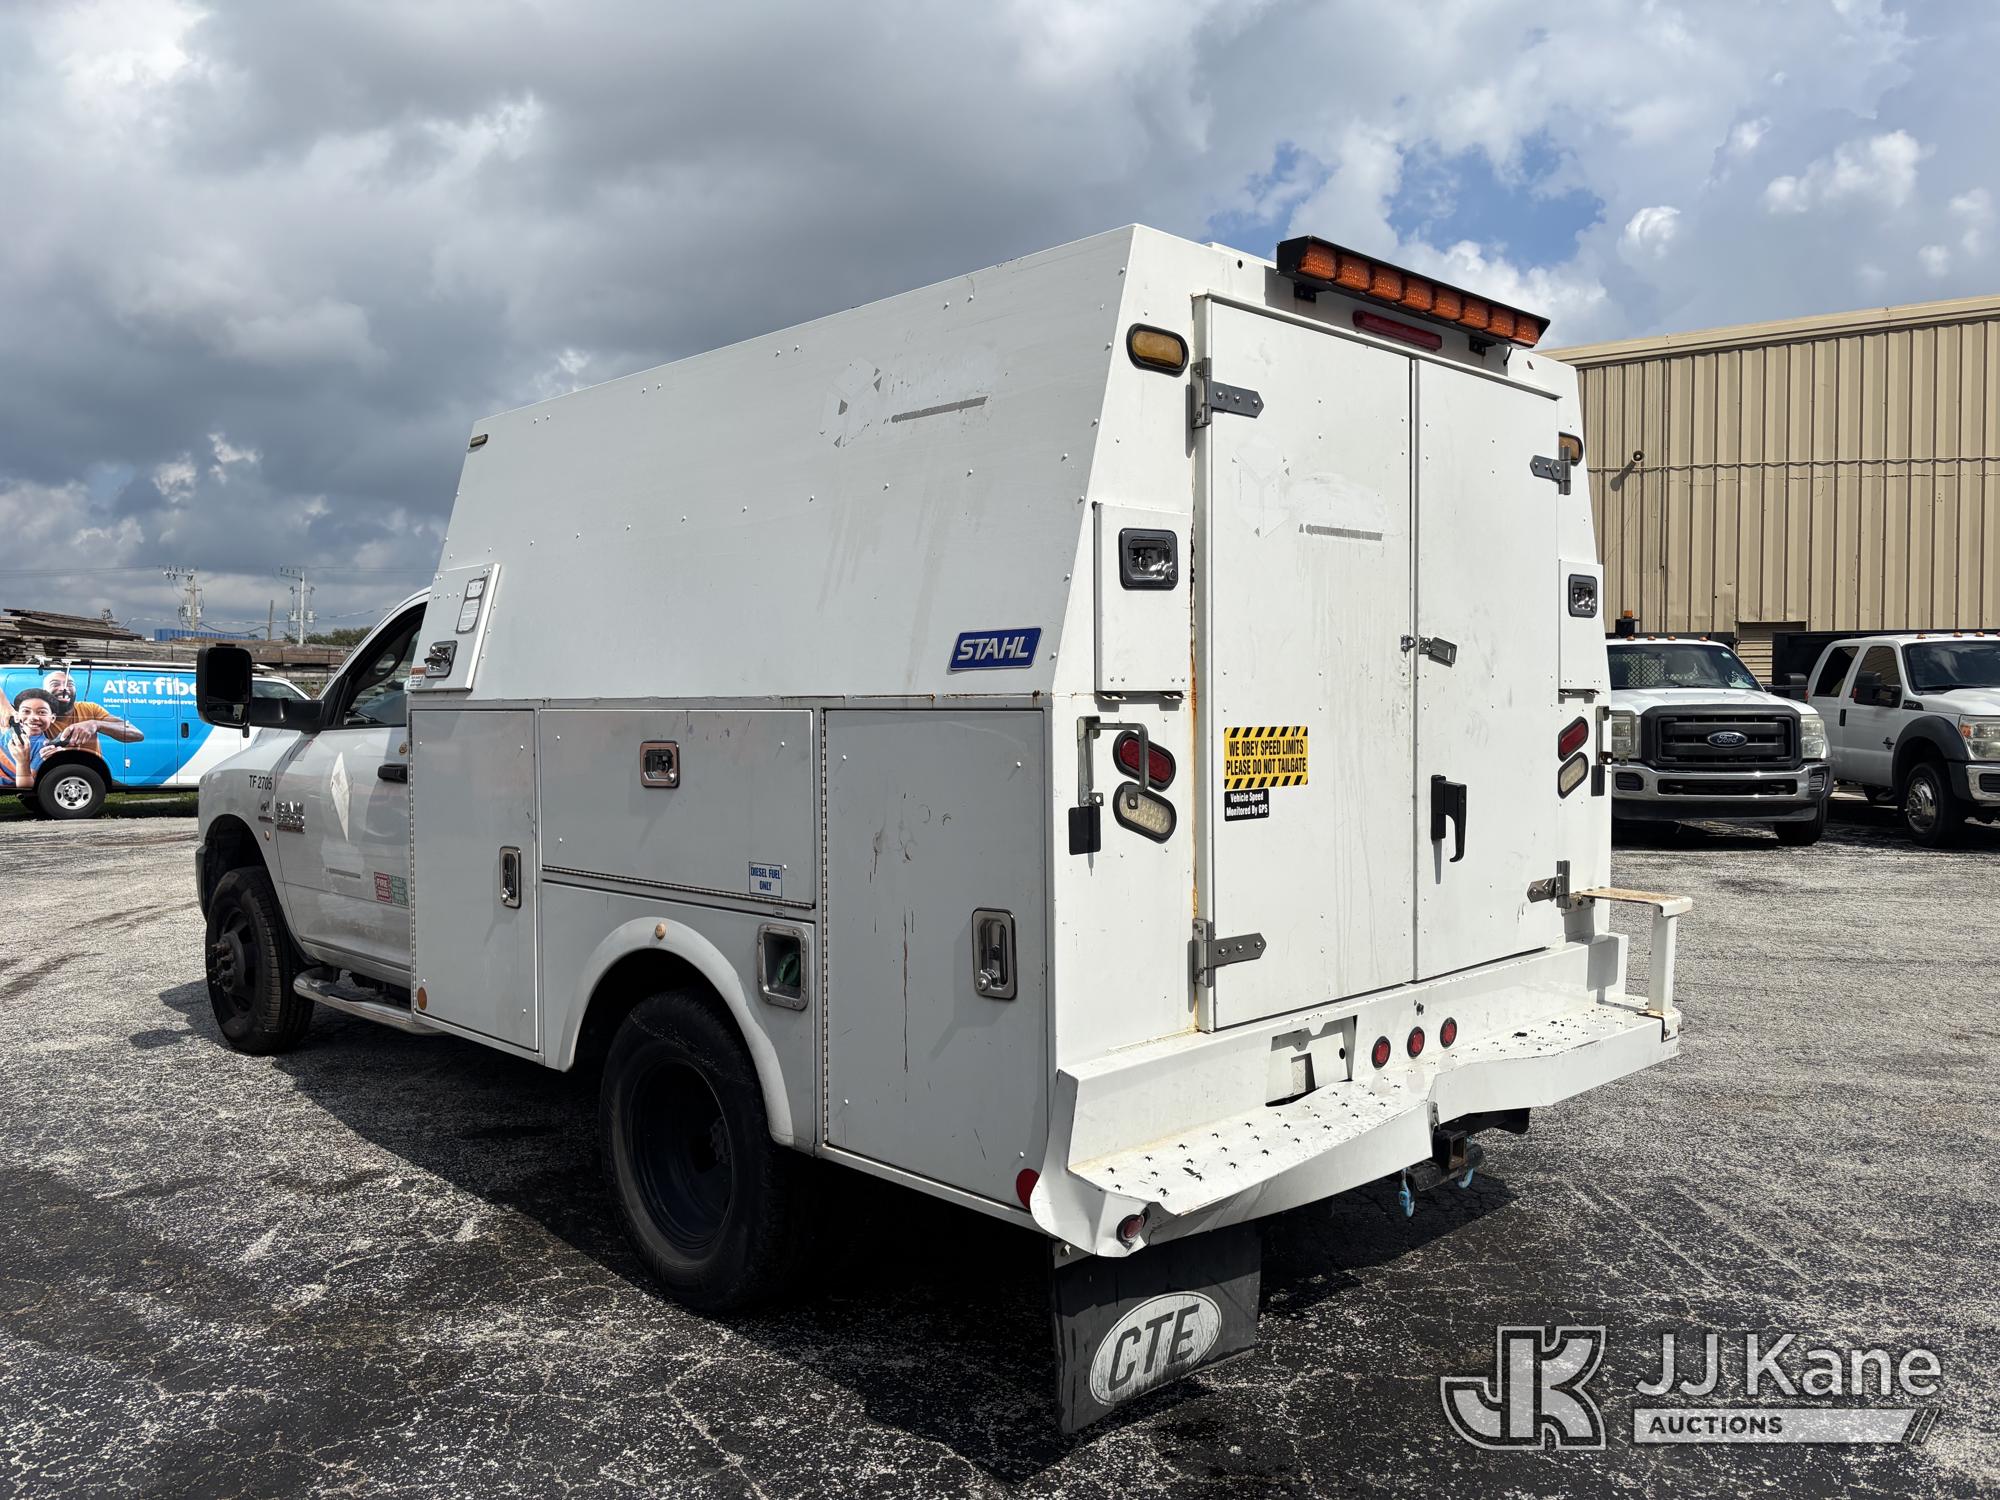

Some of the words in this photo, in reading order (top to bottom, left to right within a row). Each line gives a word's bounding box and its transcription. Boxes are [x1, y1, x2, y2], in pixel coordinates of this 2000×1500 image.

[957, 636, 1029, 660] STAHL
[103, 680, 150, 694] AT&T
[1716, 734, 1739, 743] Ford
[1229, 740, 1240, 756] WE
[1242, 740, 1259, 756] OBEY
[1260, 740, 1281, 756] SPEED
[1282, 739, 1304, 755] LIMITS
[1226, 759, 1251, 776] PLEASE
[1252, 759, 1262, 775] DO
[1263, 758, 1276, 774] NOT
[1277, 757, 1306, 773] TAILGATE
[249, 775, 257, 788] TF
[1230, 792, 1249, 803] Vehicle
[1249, 791, 1264, 803] Speed
[1226, 805, 1251, 817] Monitored
[1251, 805, 1258, 816] By
[1258, 804, 1268, 814] GPS
[751, 867, 767, 878] DIESEL
[769, 869, 780, 879] FUEL
[760, 881, 772, 890] ONLY
[1108, 1303, 1200, 1392] CTE
